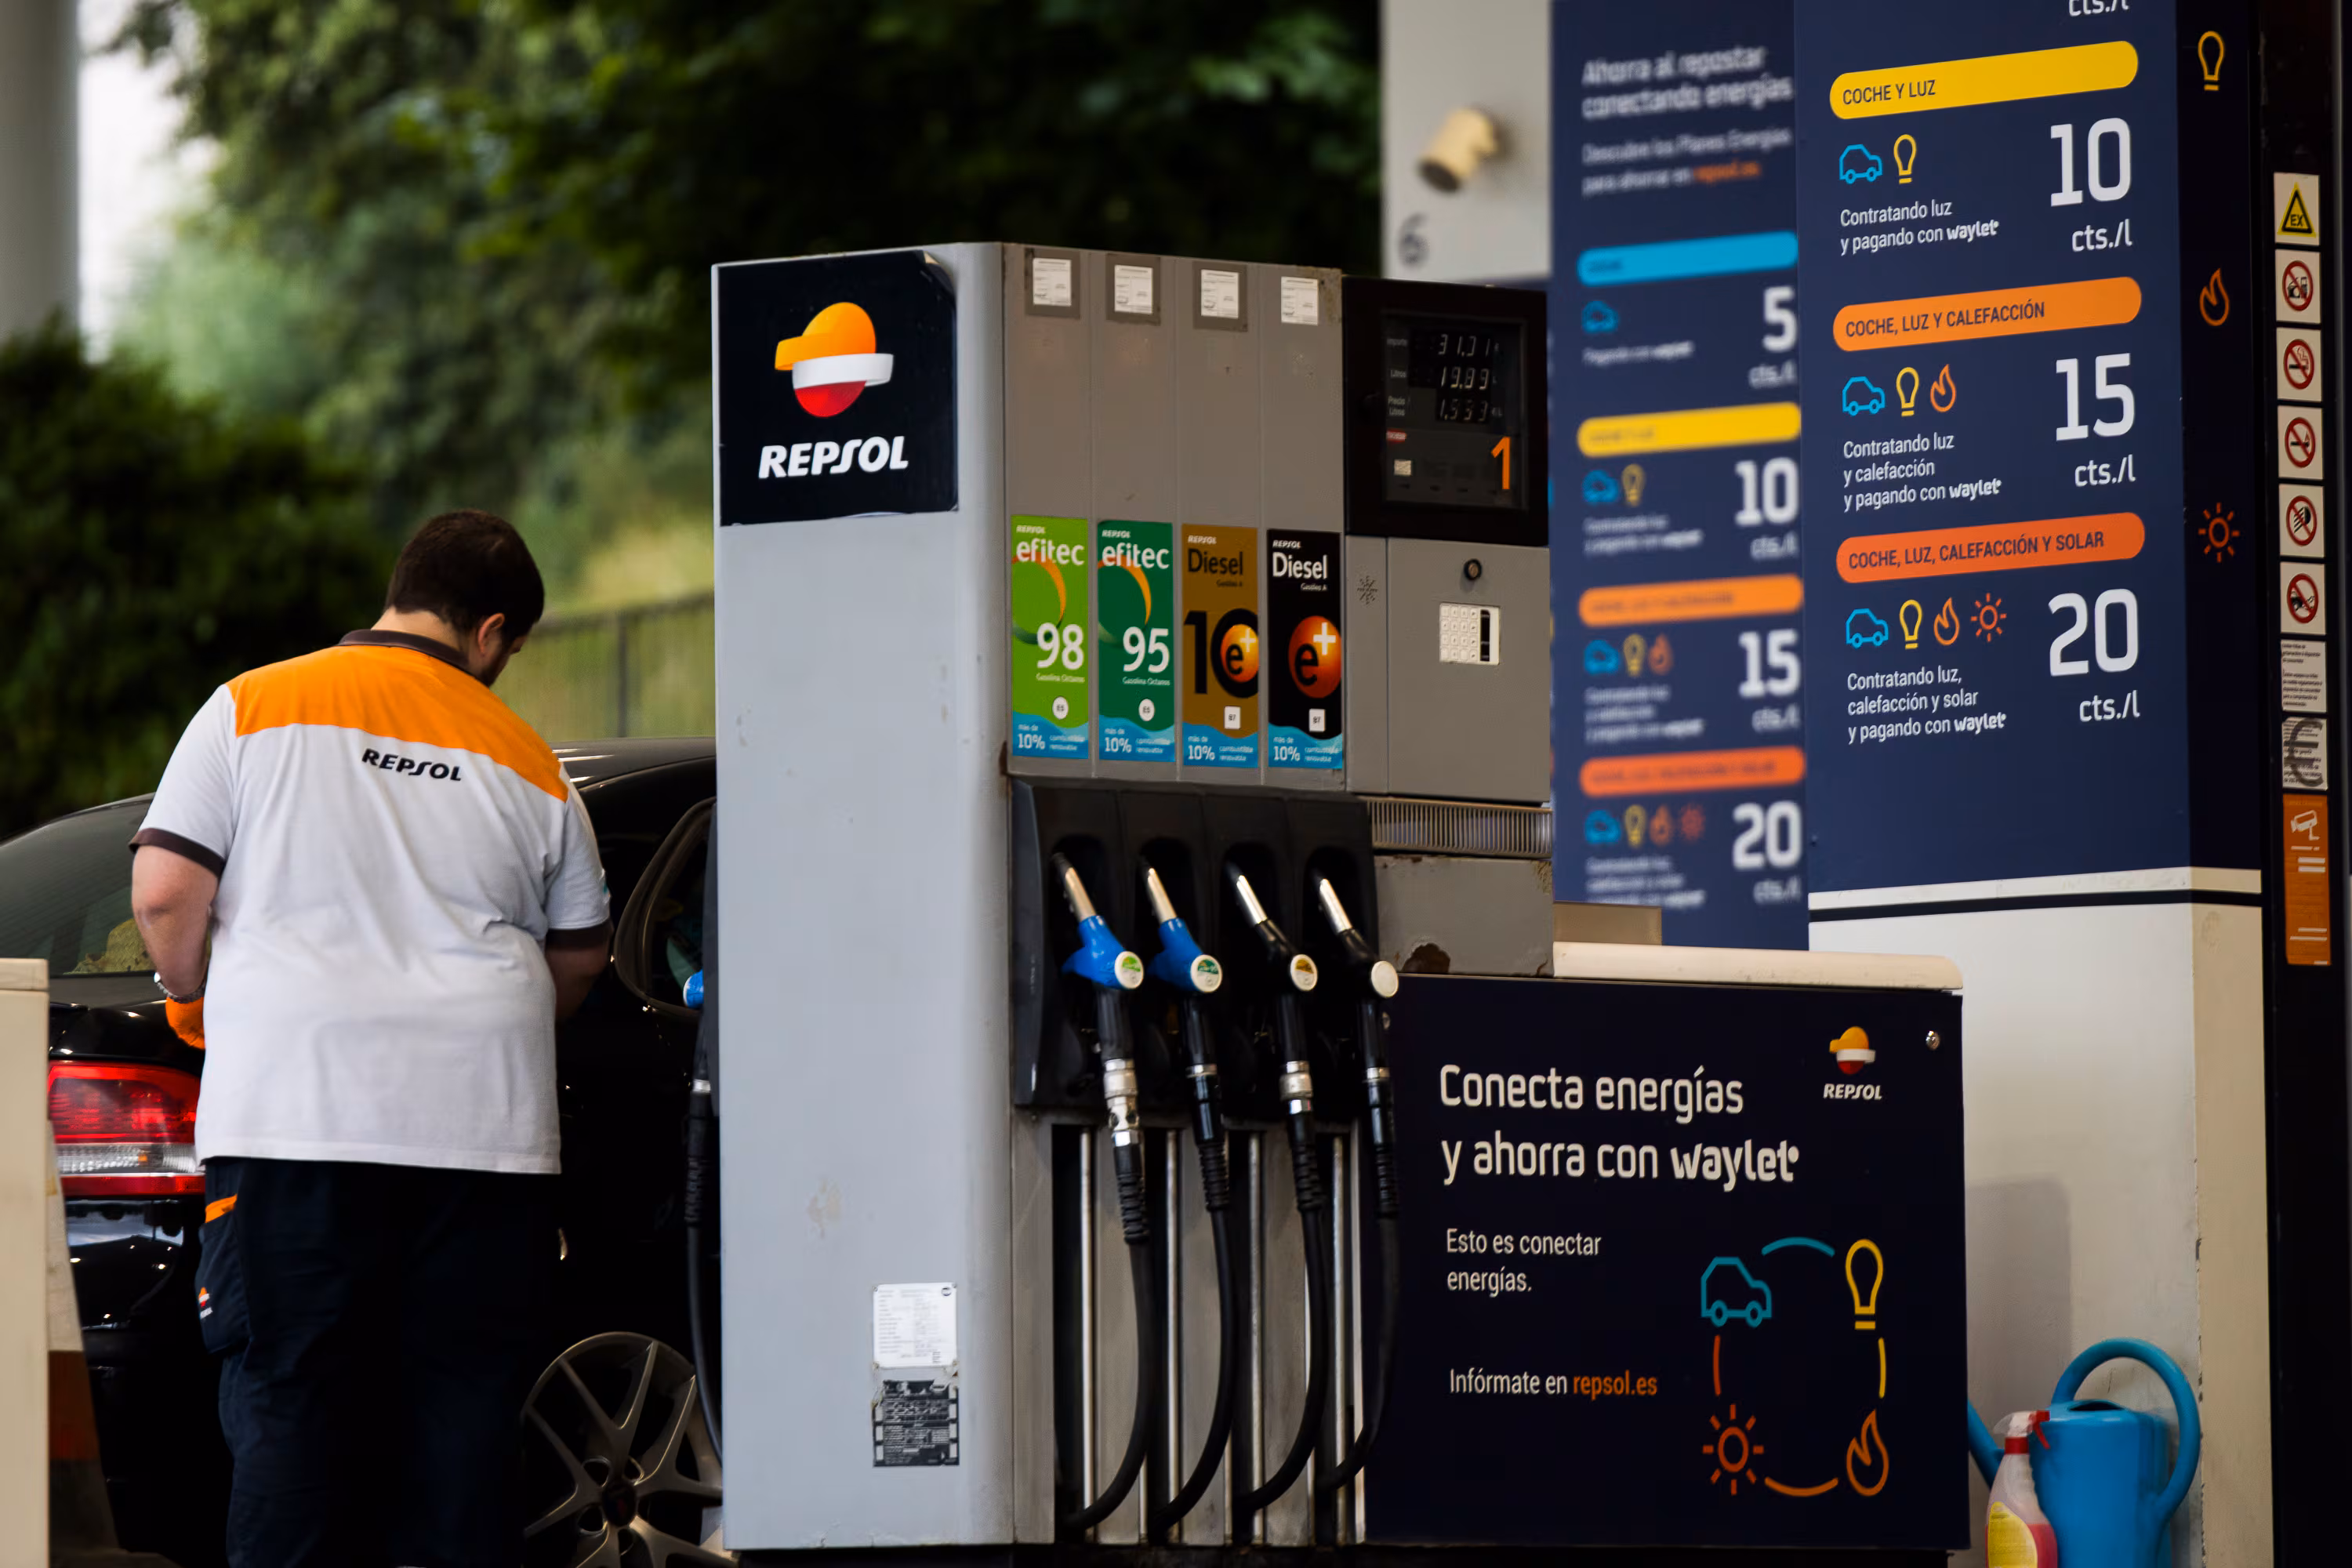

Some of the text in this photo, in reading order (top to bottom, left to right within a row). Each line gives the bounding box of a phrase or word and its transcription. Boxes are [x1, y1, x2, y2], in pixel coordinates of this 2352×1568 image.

[1842, 80, 1936, 105] COCHE Y LUZ
[2051, 118, 2132, 207] 10
[1840, 199, 1952, 227] Contratando luz
[2290, 214, 2303, 227] EX
[1840, 220, 1999, 256] y pagando con waylet
[2071, 219, 2133, 252] cts./l
[1762, 285, 1798, 352] 5
[1846, 299, 2045, 337] COCHE, LUZ Y CALEFACCIÓN
[2056, 352, 2134, 441] 15
[758, 436, 909, 479] REPSOL
[1843, 432, 1955, 459] Contratando luz
[1491, 436, 1511, 490] 1
[1843, 459, 1935, 488] y calefacción
[2074, 454, 2136, 487] cts./l
[1735, 456, 1799, 527] 10
[1843, 477, 2002, 513] y pagando con waylet
[1016, 537, 1085, 566] efitec
[1102, 542, 1170, 569] efitec
[1188, 535, 1217, 545] REPSOL
[1272, 539, 1301, 549] REPSOL
[1849, 532, 2103, 569] COCHE, LUZ, CALEFACCIÓN Y SOLAR
[1188, 548, 1243, 575] Diesel
[1272, 552, 1327, 579] Diesel
[1036, 622, 1084, 670] 98
[1123, 626, 1171, 673] 95
[2048, 589, 2139, 677] 20
[1183, 608, 1258, 699] 10
[1738, 629, 1802, 699] 15
[1847, 665, 1962, 691] Contratando luz,
[1848, 689, 1979, 716] calefacción y solar
[2079, 690, 2140, 722] cts./l
[1018, 733, 1046, 750] 10%
[1105, 737, 1132, 753] 10%
[1848, 713, 2006, 744] y pagando con waylet
[361, 748, 461, 781] REPSOL
[1188, 745, 1215, 760] 10%
[1273, 746, 1301, 761] 10%
[1732, 800, 1802, 871] 20
[1440, 1064, 1744, 1124] Conecta energías
[1823, 1083, 1882, 1100] REPSOL
[1441, 1130, 1799, 1192] y ahorra con waylet
[1446, 1228, 1602, 1256] Esto es conectar
[1447, 1265, 1532, 1298] energías.
[1450, 1367, 1657, 1401] Infórmate en repsol.es
